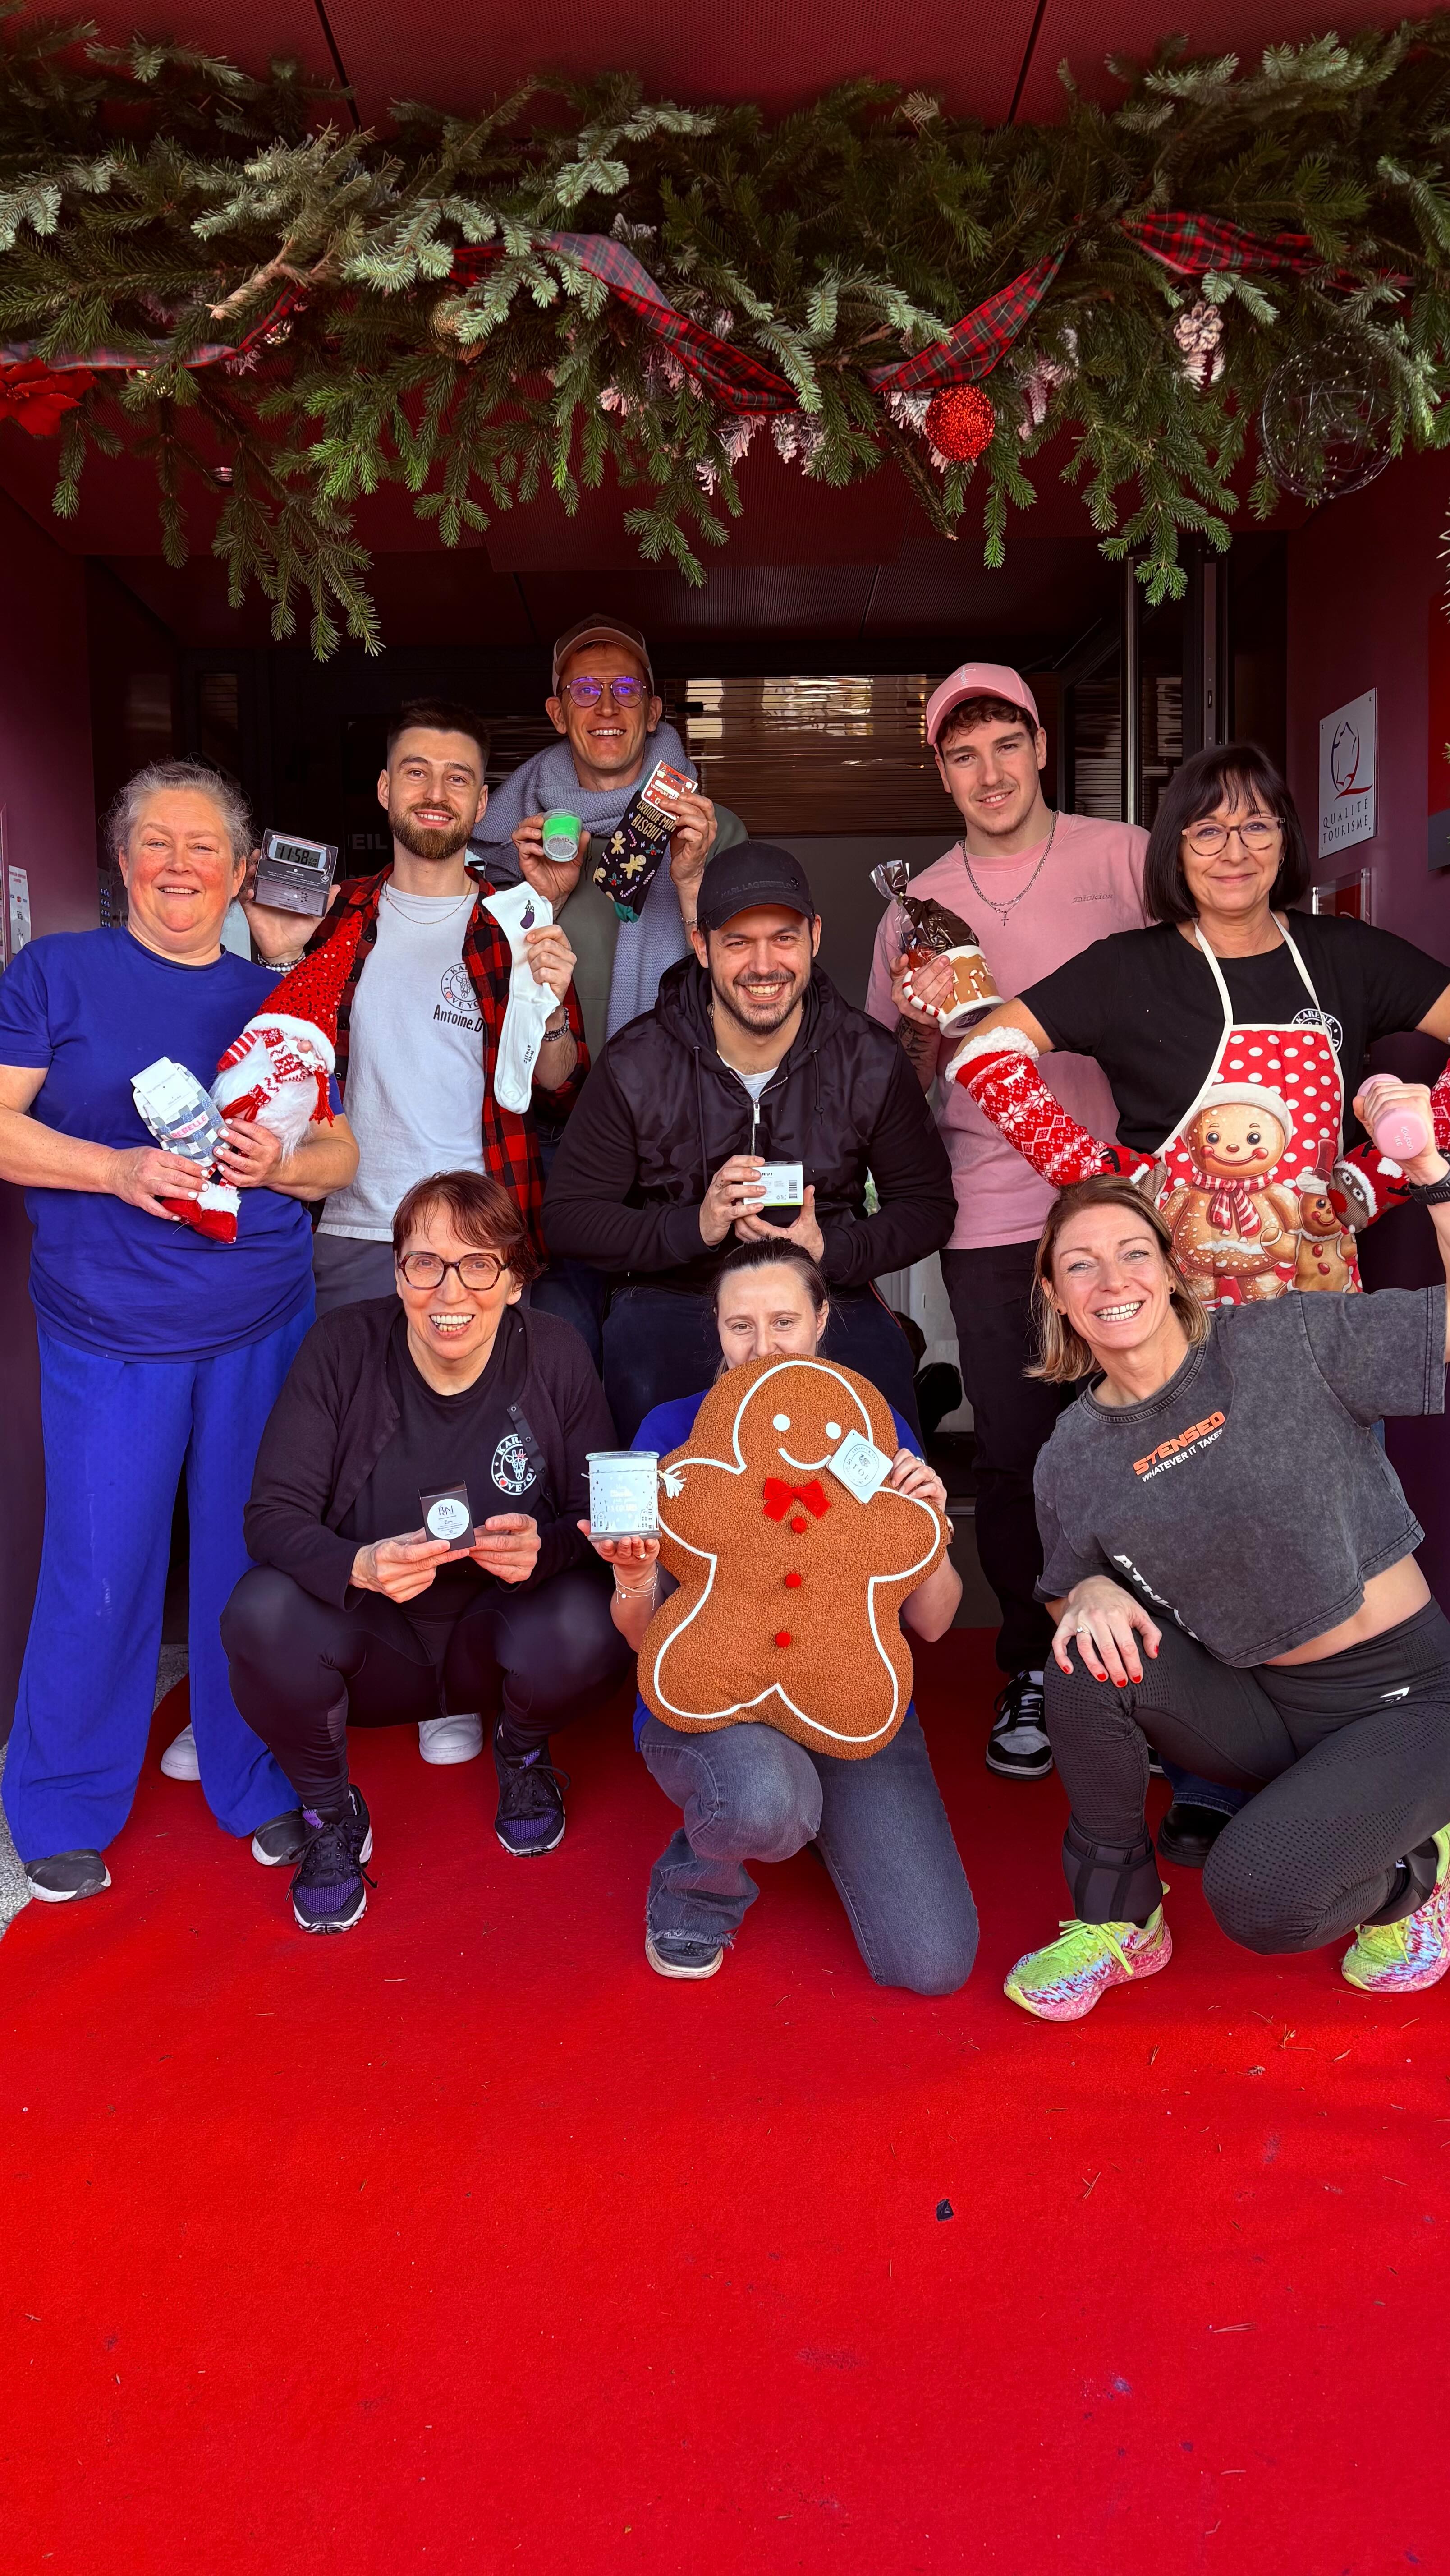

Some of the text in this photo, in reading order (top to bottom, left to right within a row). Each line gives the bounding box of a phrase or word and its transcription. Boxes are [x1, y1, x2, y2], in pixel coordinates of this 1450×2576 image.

[636, 800, 663, 824] CROQUE
[1323, 795, 1367, 828] QUALITÉ
[348, 834, 388, 850] EIL
[631, 813, 665, 842] BISCUIT
[1323, 815, 1367, 844] TOURISME
[279, 845, 310, 864] 11:58
[171, 1115, 206, 1137] REBELLE
[1133, 1411, 1225, 1476] STENSED
[1142, 1428, 1223, 1483] WHATEVER IT TAKES
